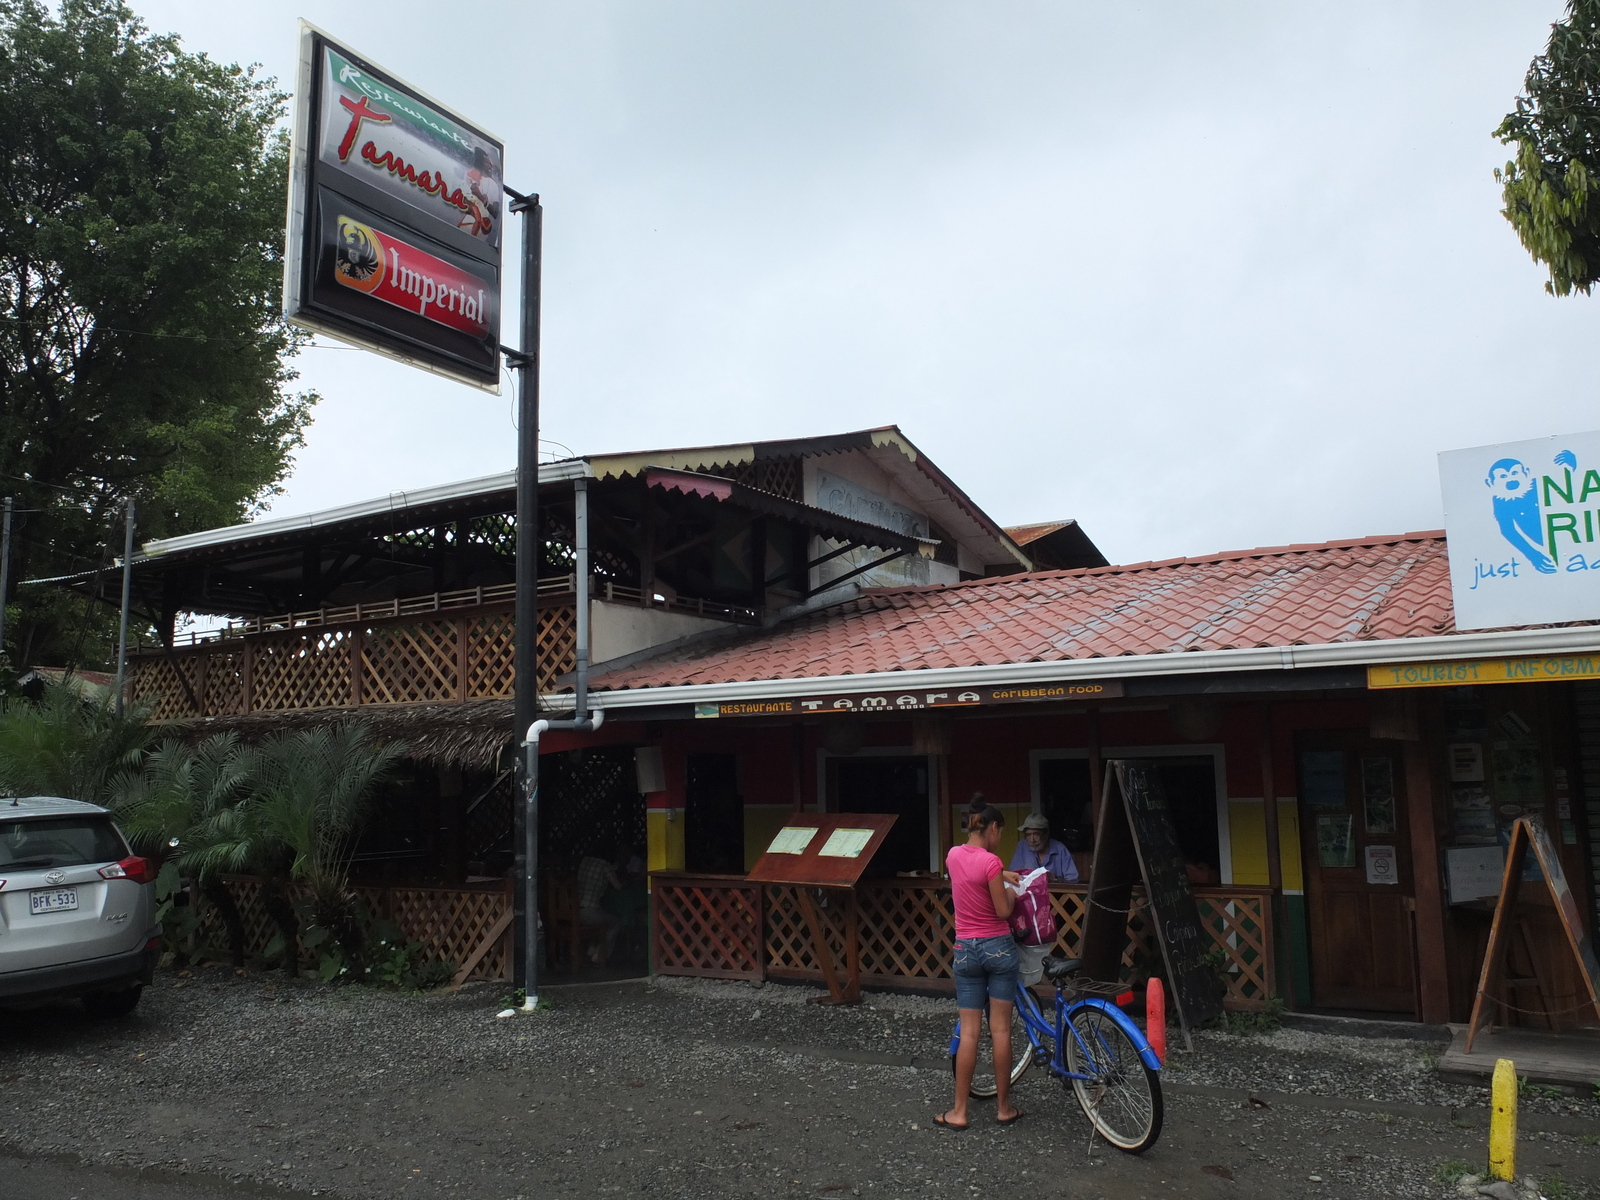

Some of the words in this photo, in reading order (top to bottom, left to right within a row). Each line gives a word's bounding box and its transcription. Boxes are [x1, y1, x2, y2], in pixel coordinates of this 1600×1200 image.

[339, 64, 473, 151] Restaurante
[337, 95, 469, 212] Tamara
[388, 246, 484, 325] Imperial
[1546, 508, 1600, 568] RI
[1469, 556, 1521, 590] just
[1390, 662, 1482, 683] TOURIST
[1504, 655, 1600, 678] INFORM
[720, 701, 793, 714] RESTAURANTE
[801, 690, 981, 711] TAMARA
[992, 686, 1064, 699] CARIBBEAN
[1068, 684, 1103, 694] FOOD
[32, 892, 76, 909] BFK-533
